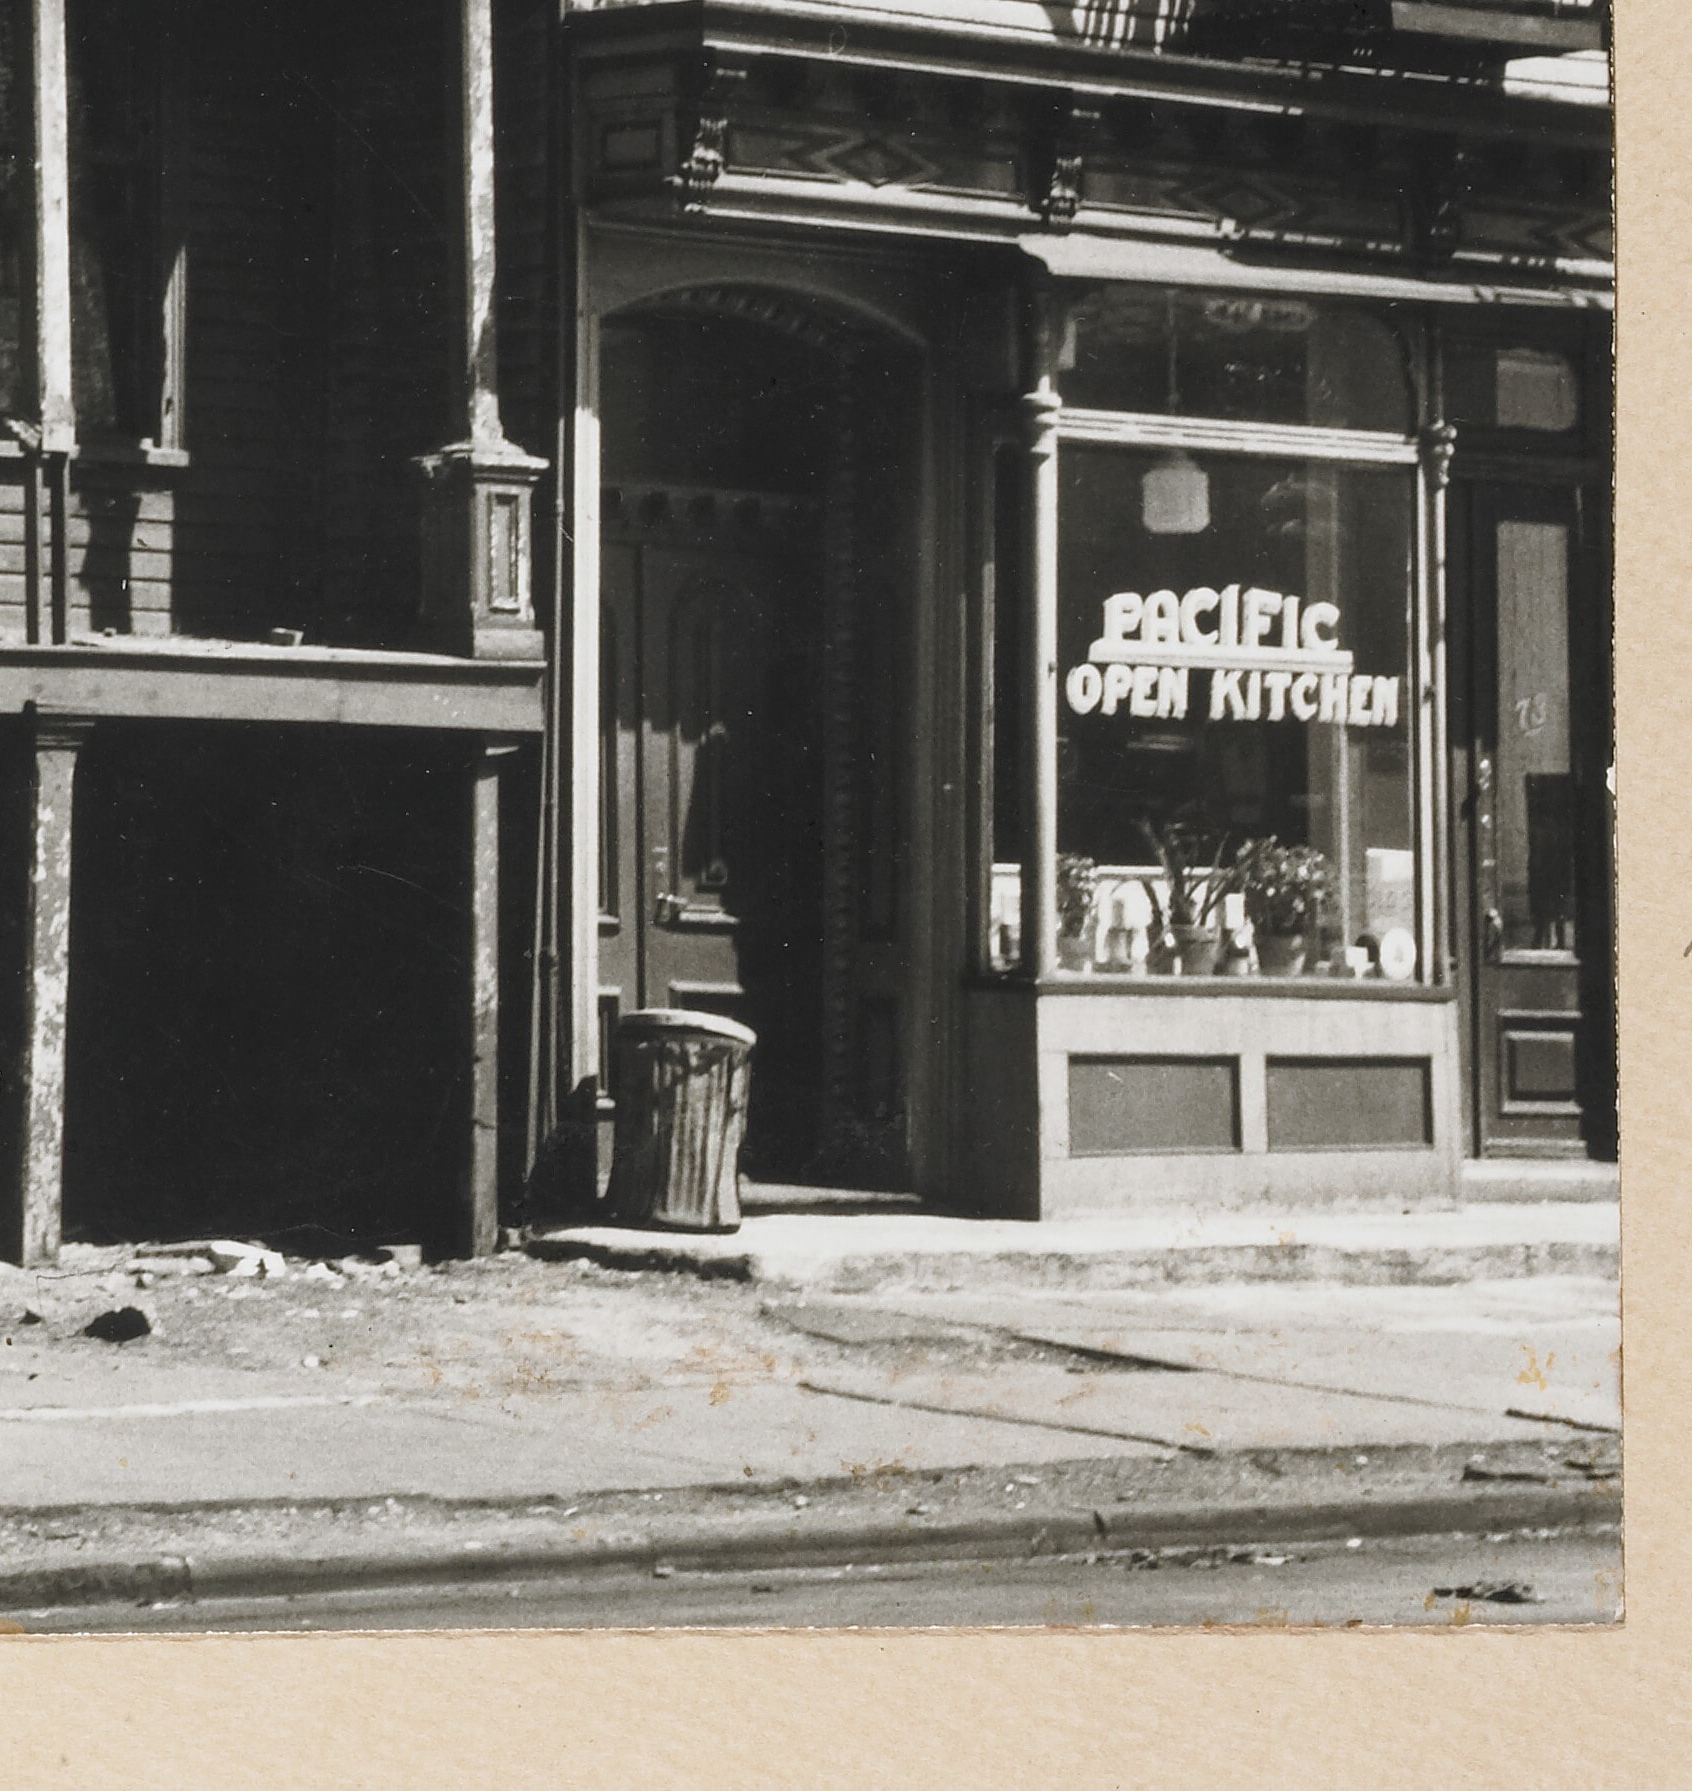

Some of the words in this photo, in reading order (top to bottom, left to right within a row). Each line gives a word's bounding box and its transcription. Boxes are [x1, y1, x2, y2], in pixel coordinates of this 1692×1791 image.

[1102, 583, 1341, 651] PACIFIC
[1065, 662, 1190, 720] OPEN
[1208, 667, 1400, 727] KITCHEN
